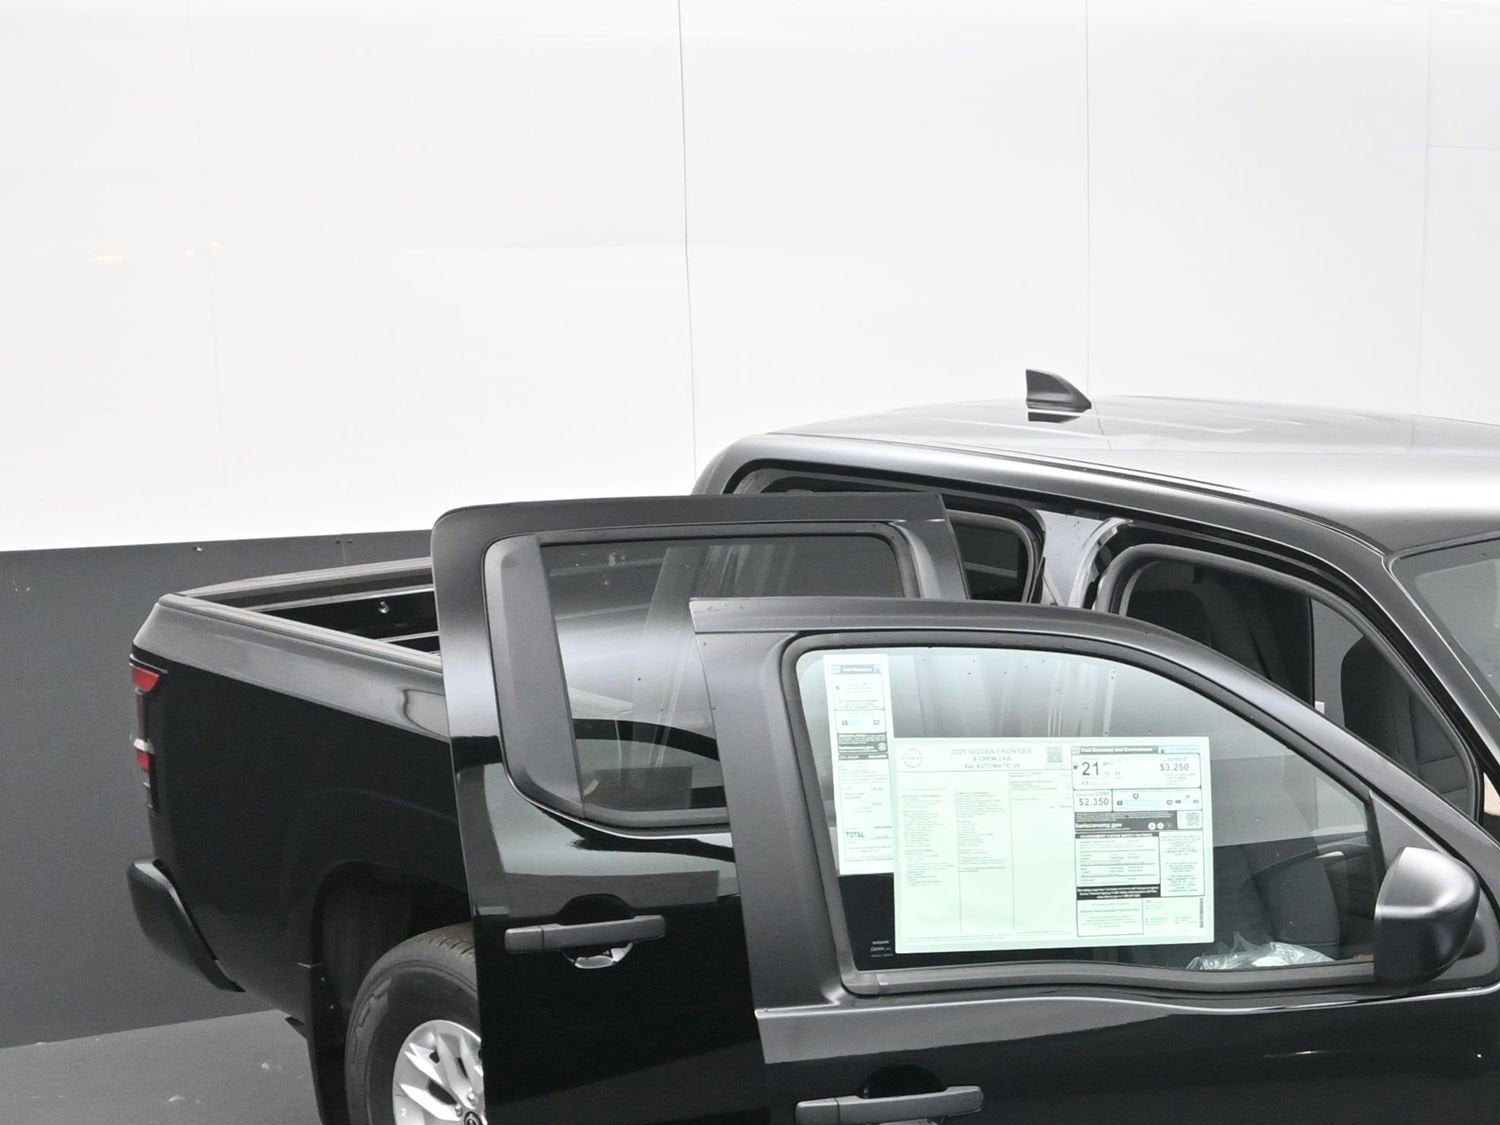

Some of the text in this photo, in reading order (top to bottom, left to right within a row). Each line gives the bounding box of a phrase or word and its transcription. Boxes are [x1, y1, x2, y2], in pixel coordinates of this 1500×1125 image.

[996, 747, 1033, 755] FRONTIER
[1081, 761, 1100, 776] 21
[1159, 762, 1190, 772] $3,250
[1078, 797, 1109, 807] $2,350
